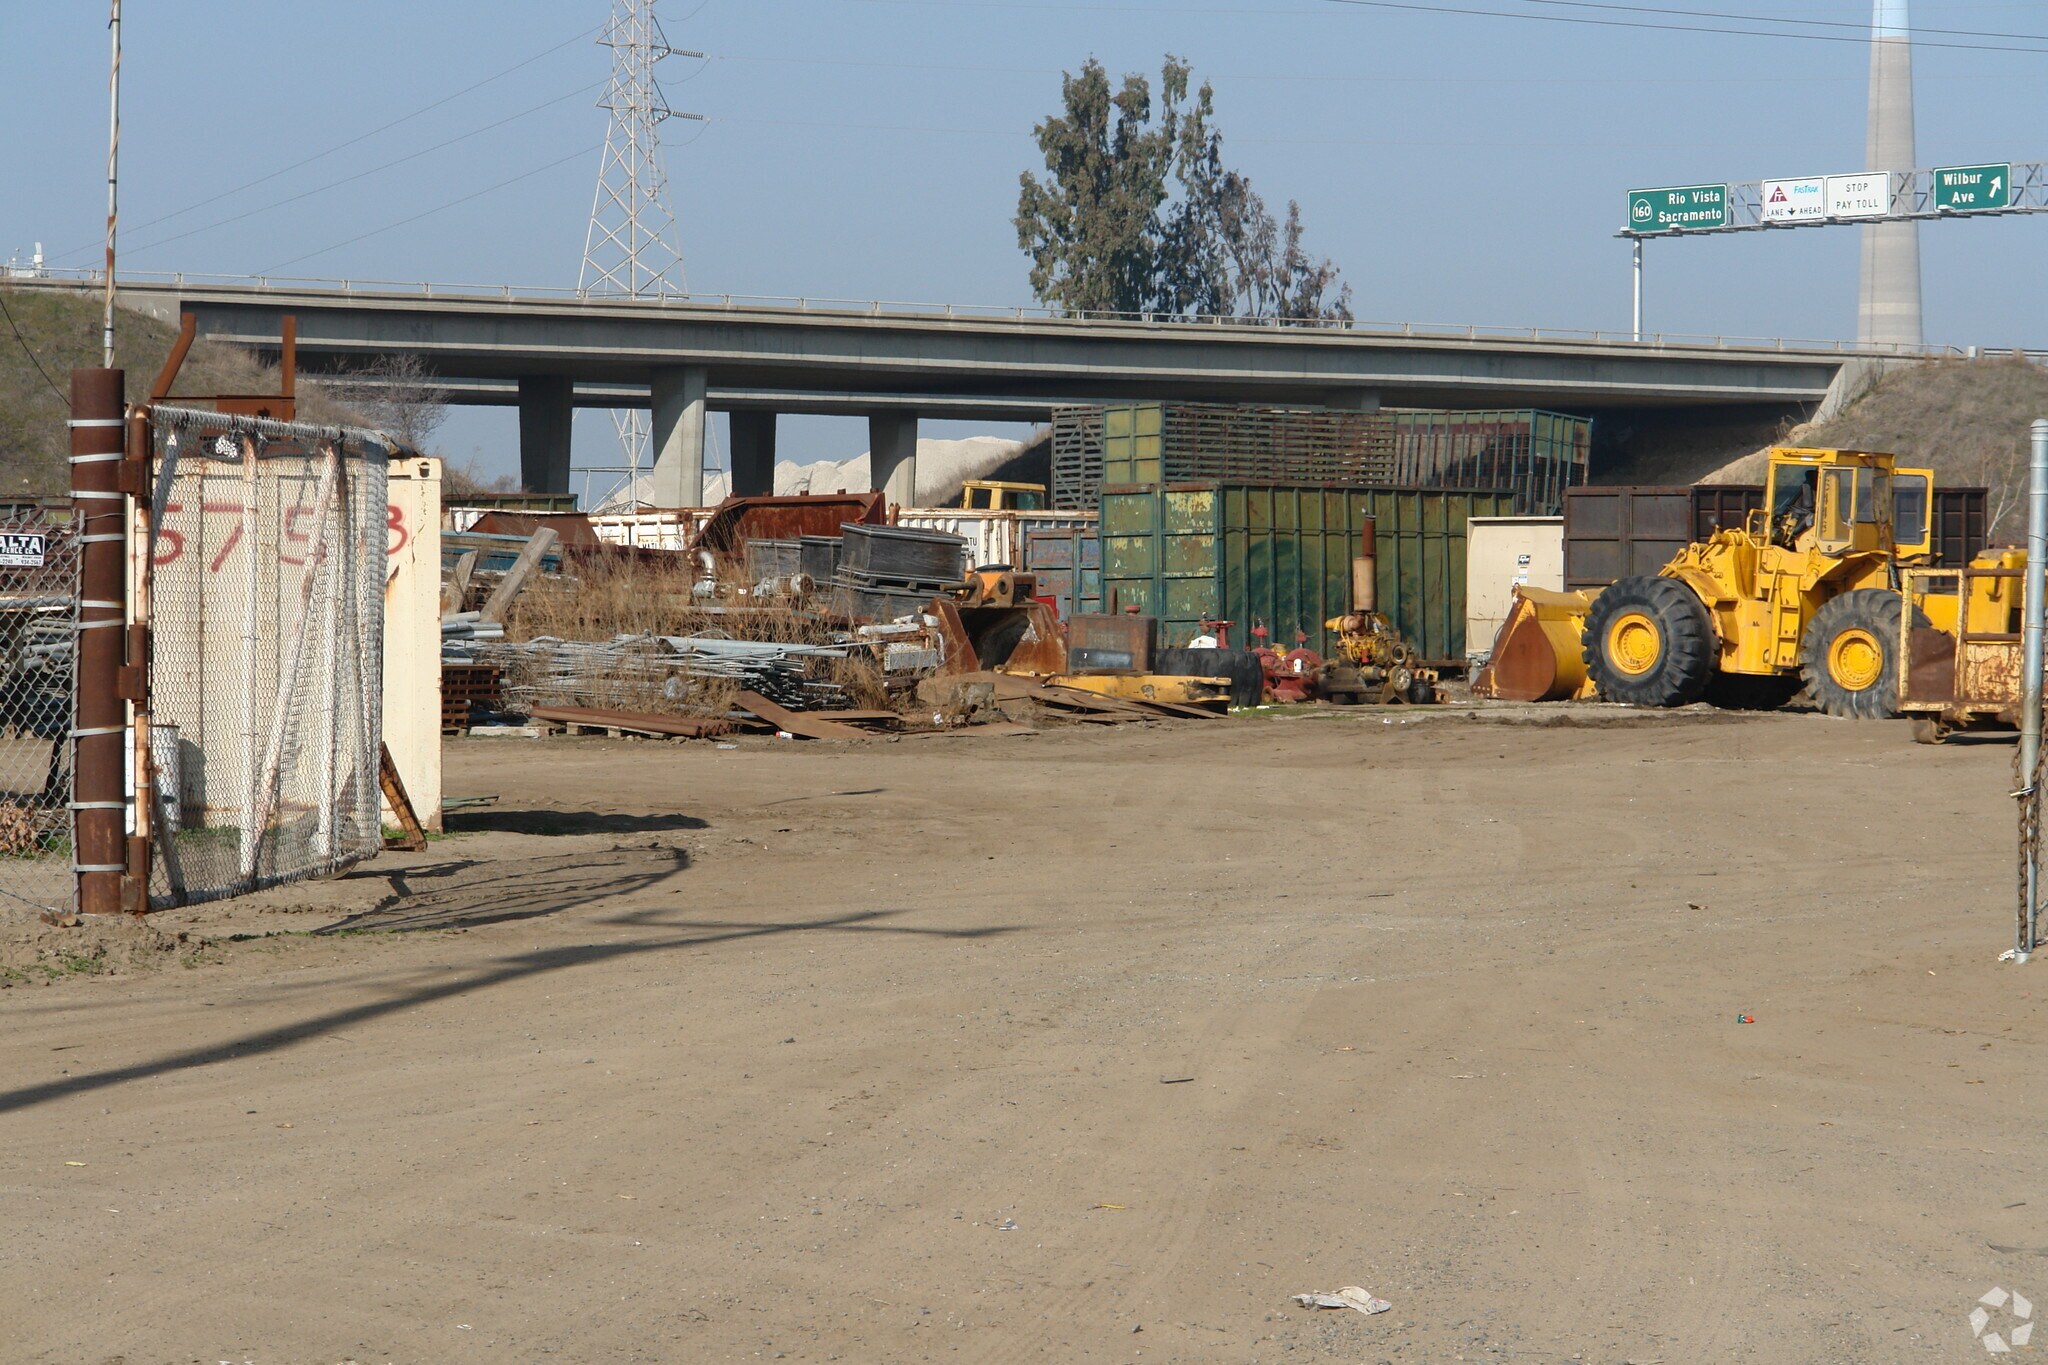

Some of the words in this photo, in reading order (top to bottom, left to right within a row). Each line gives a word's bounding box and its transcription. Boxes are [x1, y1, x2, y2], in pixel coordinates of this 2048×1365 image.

[1943, 173, 1983, 186] Wilbur
[1846, 183, 1869, 193] STOP
[1668, 193, 1686, 205] Rio
[1692, 191, 1721, 204] Vista
[1951, 191, 1975, 204] Ave
[1836, 200, 1852, 210] PAY
[1856, 199, 1878, 208] TOLL
[1635, 206, 1651, 218] 160
[1658, 208, 1722, 223] Sacramento
[1766, 208, 1784, 217] LANE
[1799, 206, 1822, 215] AHEAD
[2, 546, 23, 554] FENCE
